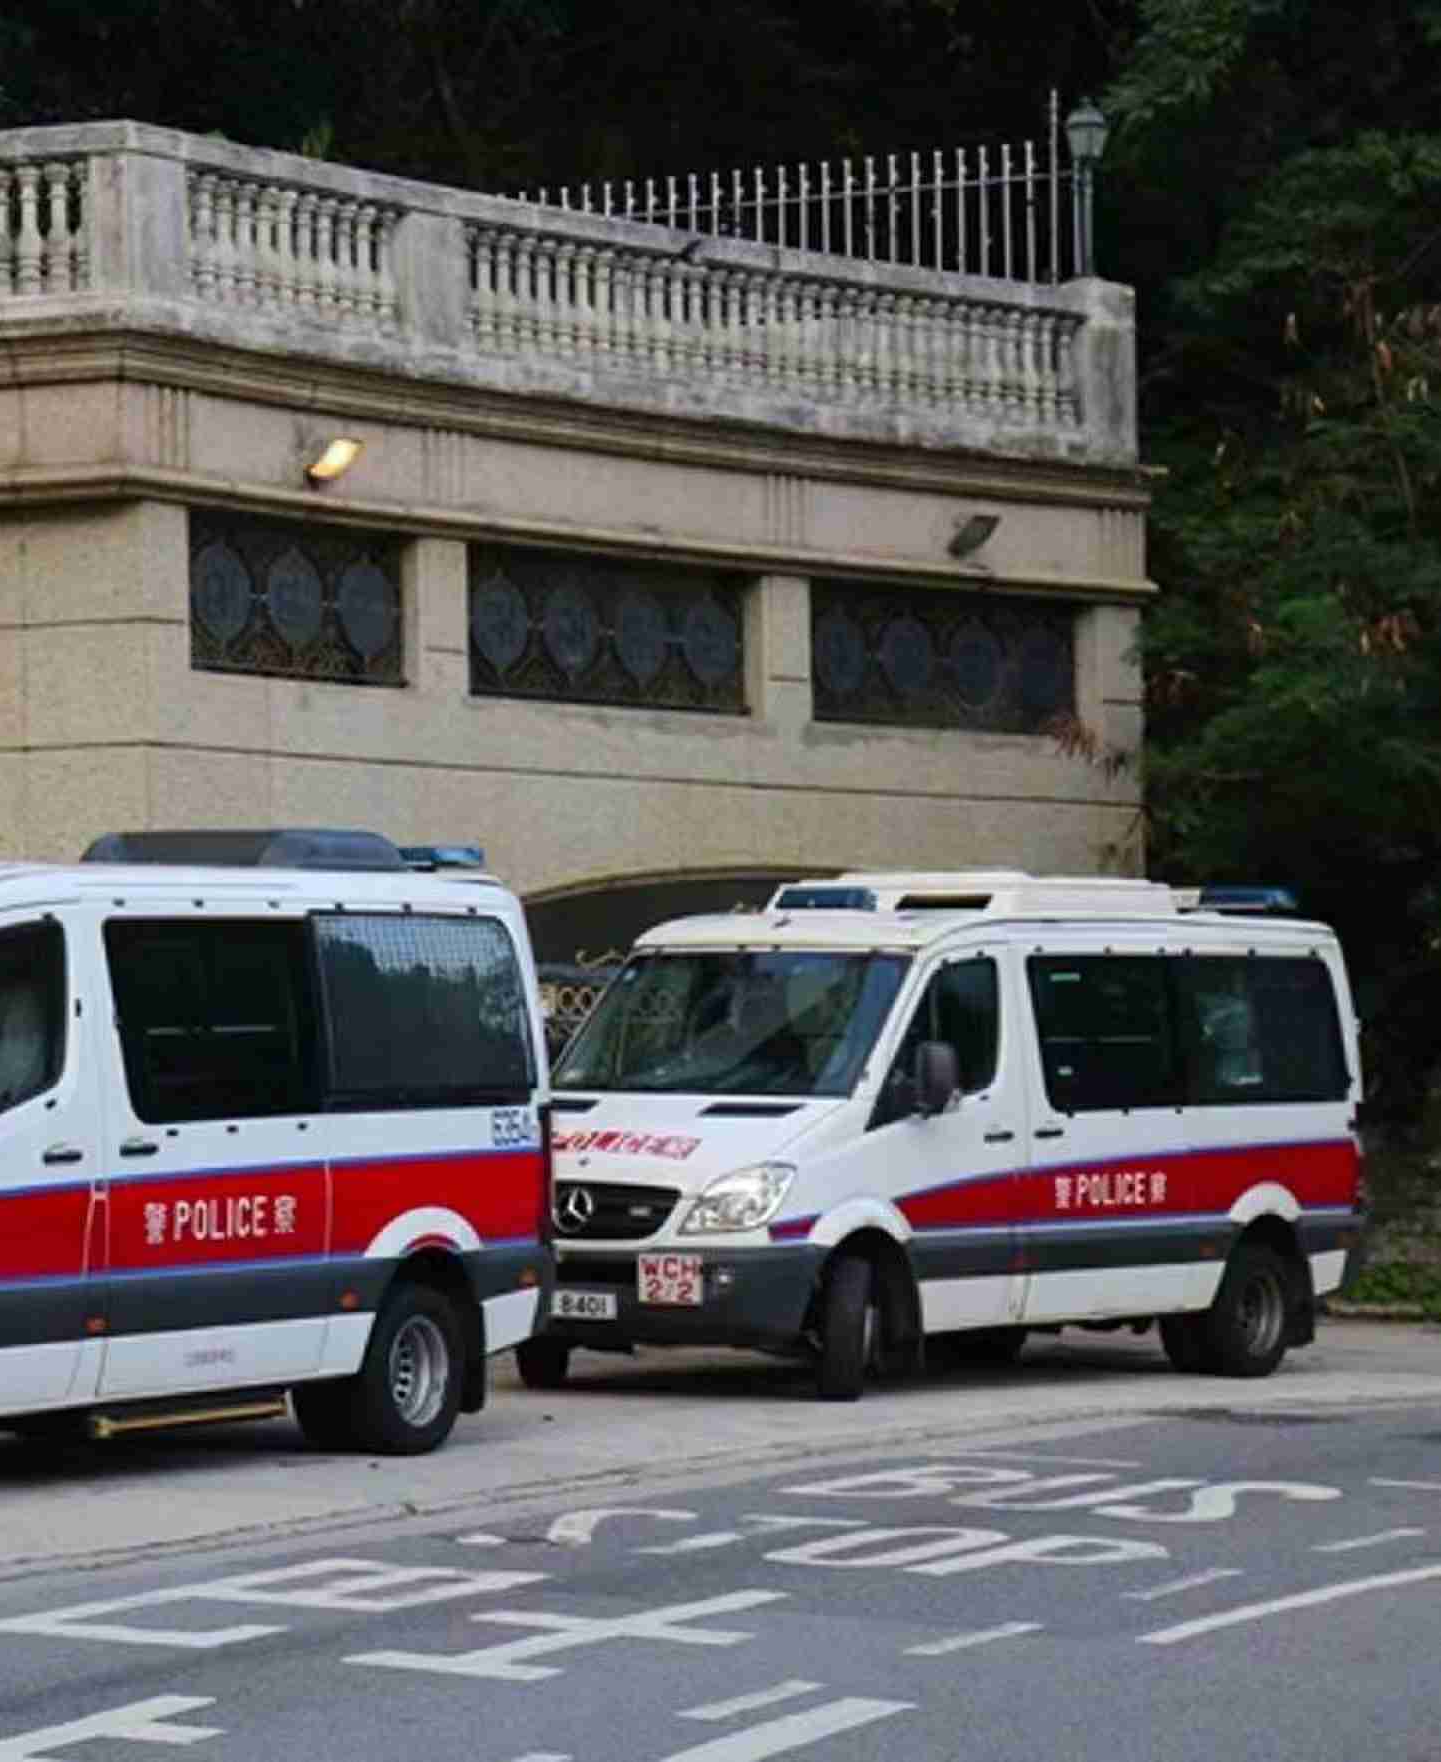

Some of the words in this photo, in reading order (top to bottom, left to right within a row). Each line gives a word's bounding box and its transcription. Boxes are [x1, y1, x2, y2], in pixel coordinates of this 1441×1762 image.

[1075, 1172, 1147, 1207] POLICE
[173, 1196, 268, 1240] POLICE
[641, 1257, 696, 1280] WCH
[774, 1465, 1342, 1523] BUS
